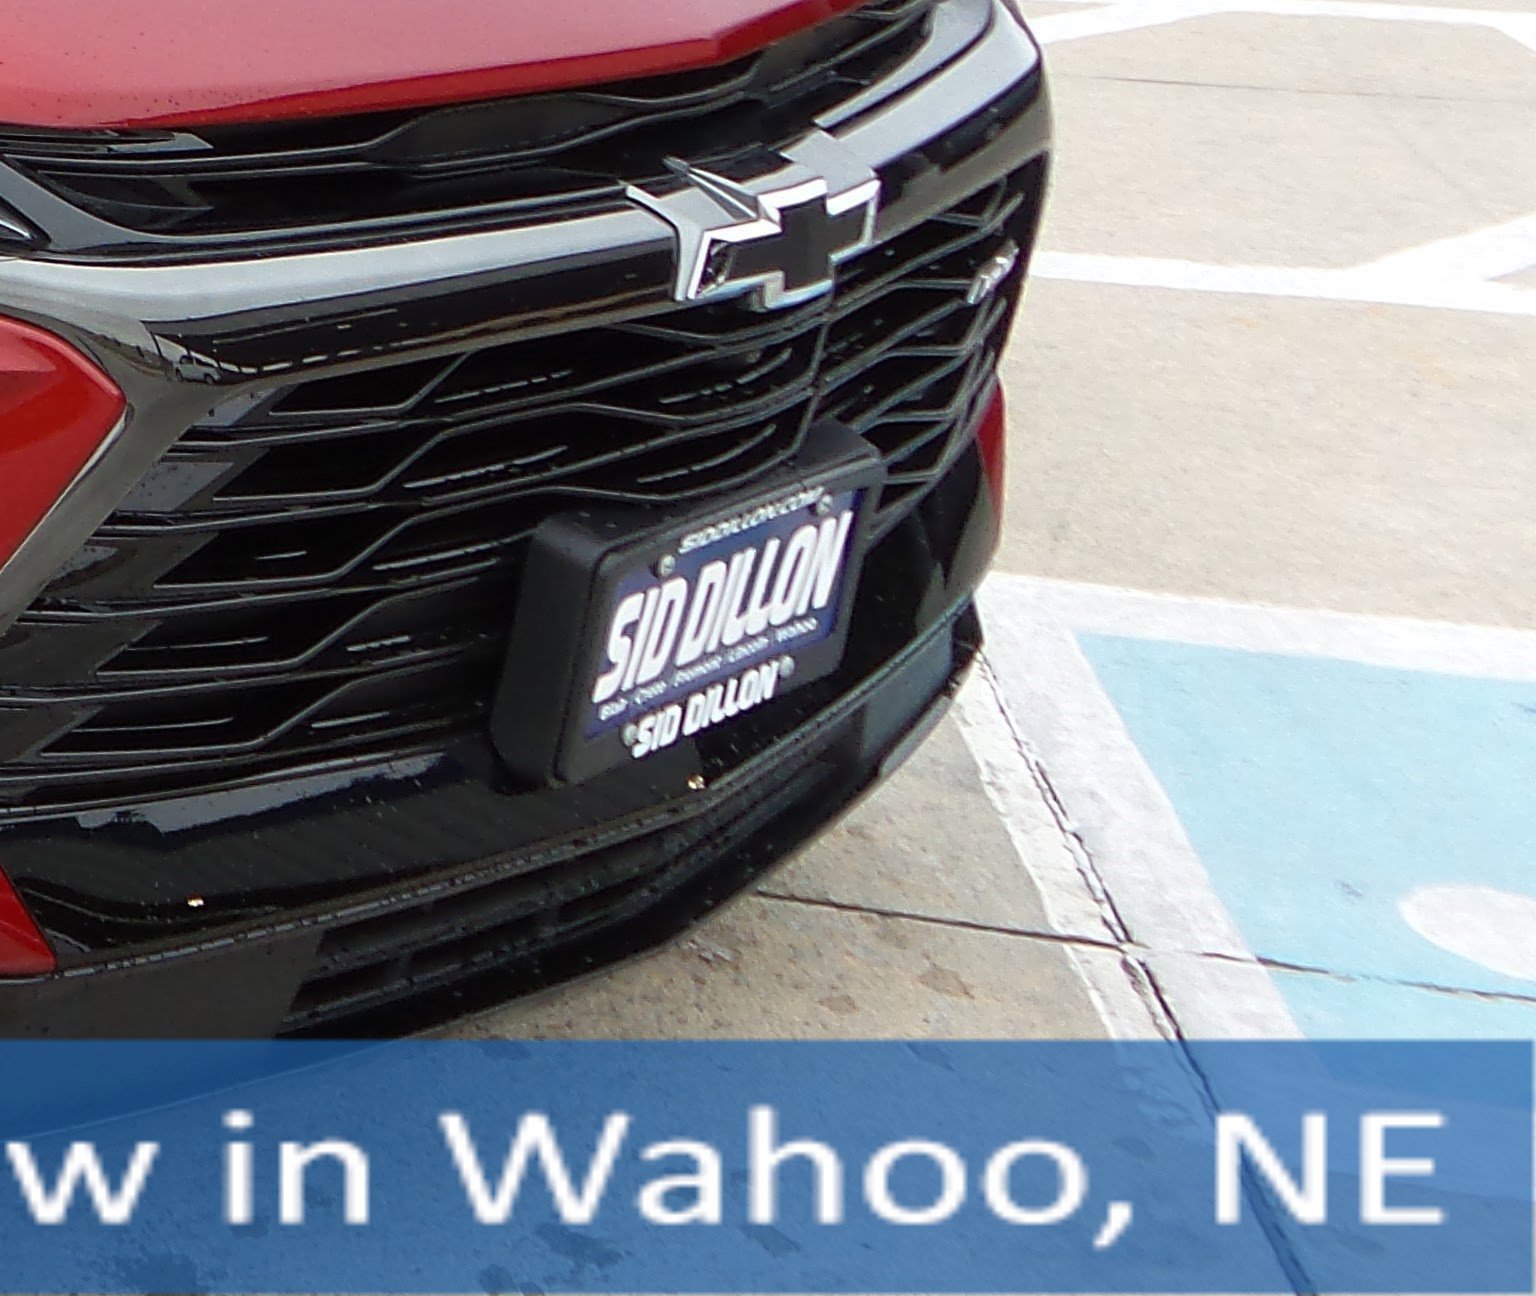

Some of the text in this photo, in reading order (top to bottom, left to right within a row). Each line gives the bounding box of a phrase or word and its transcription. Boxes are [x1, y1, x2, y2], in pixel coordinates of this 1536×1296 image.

[592, 576, 688, 704] SID
[675, 509, 855, 666] DILLON
[631, 704, 683, 759] SID
[682, 660, 780, 737] DILLON
